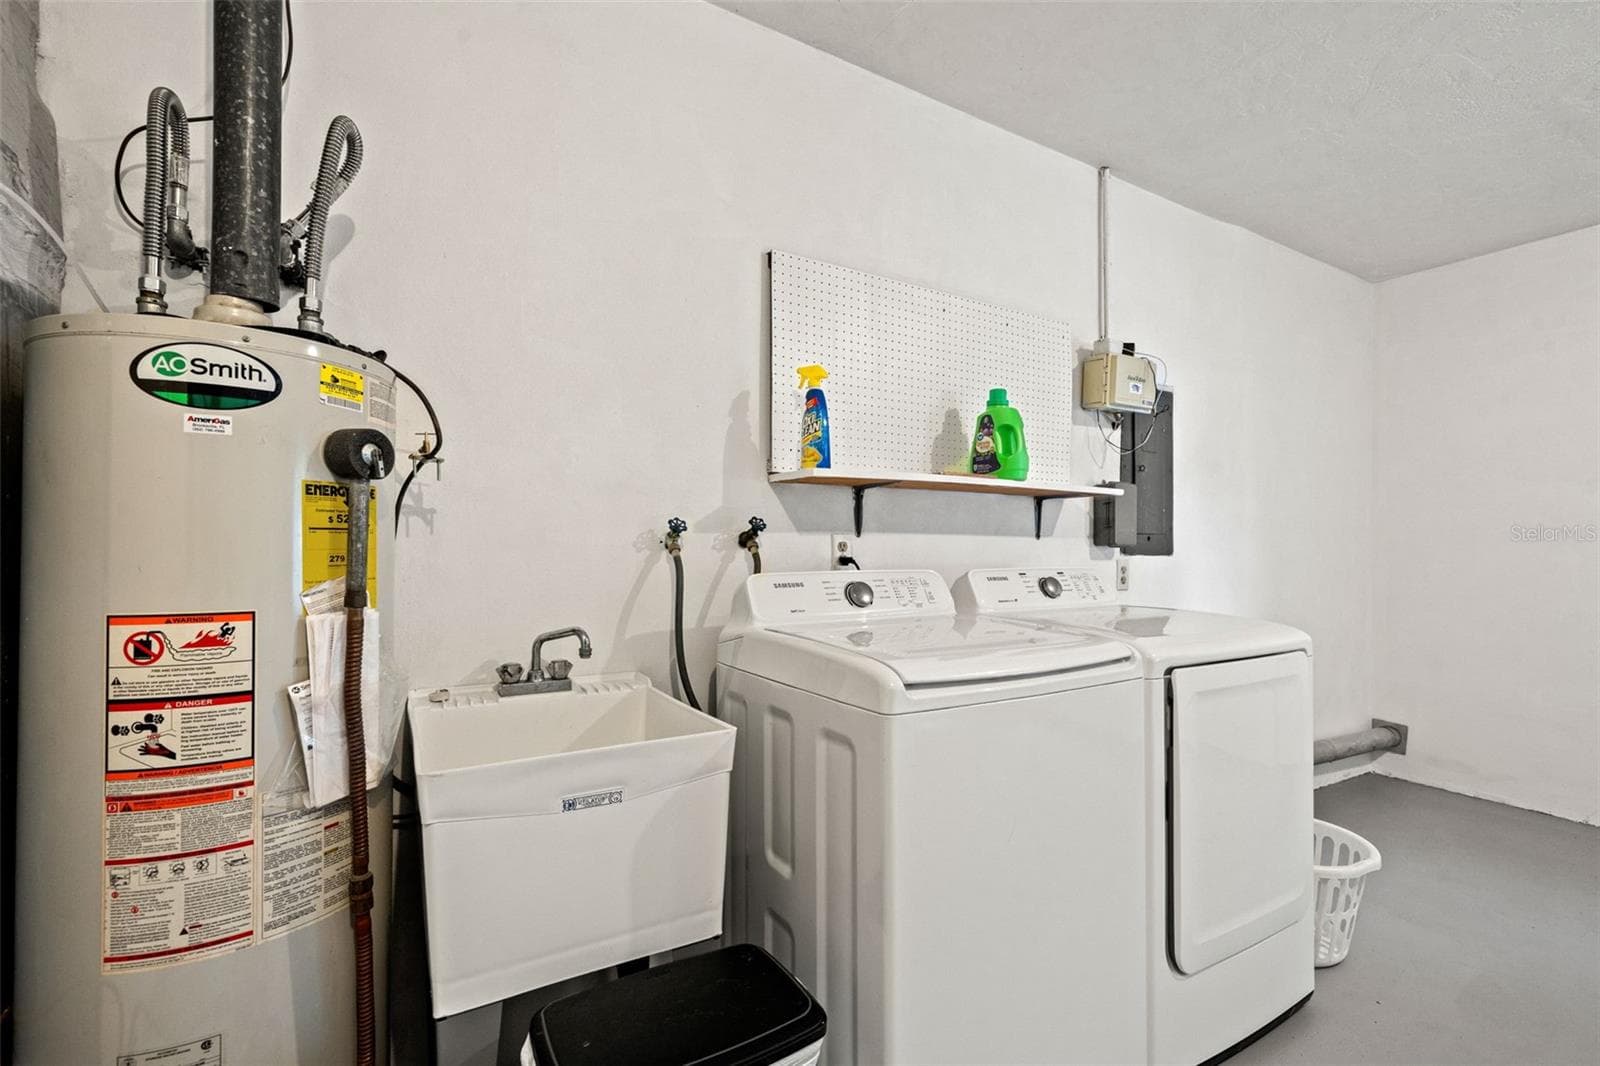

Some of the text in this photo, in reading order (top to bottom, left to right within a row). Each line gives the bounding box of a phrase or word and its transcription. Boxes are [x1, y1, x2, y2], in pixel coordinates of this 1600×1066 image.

[187, 415, 231, 425] AmeriGas
[329, 555, 345, 563] 279
[773, 581, 805, 589] SAMSUNG
[172, 616, 214, 624] WARNING
[175, 698, 213, 708] DANGER
